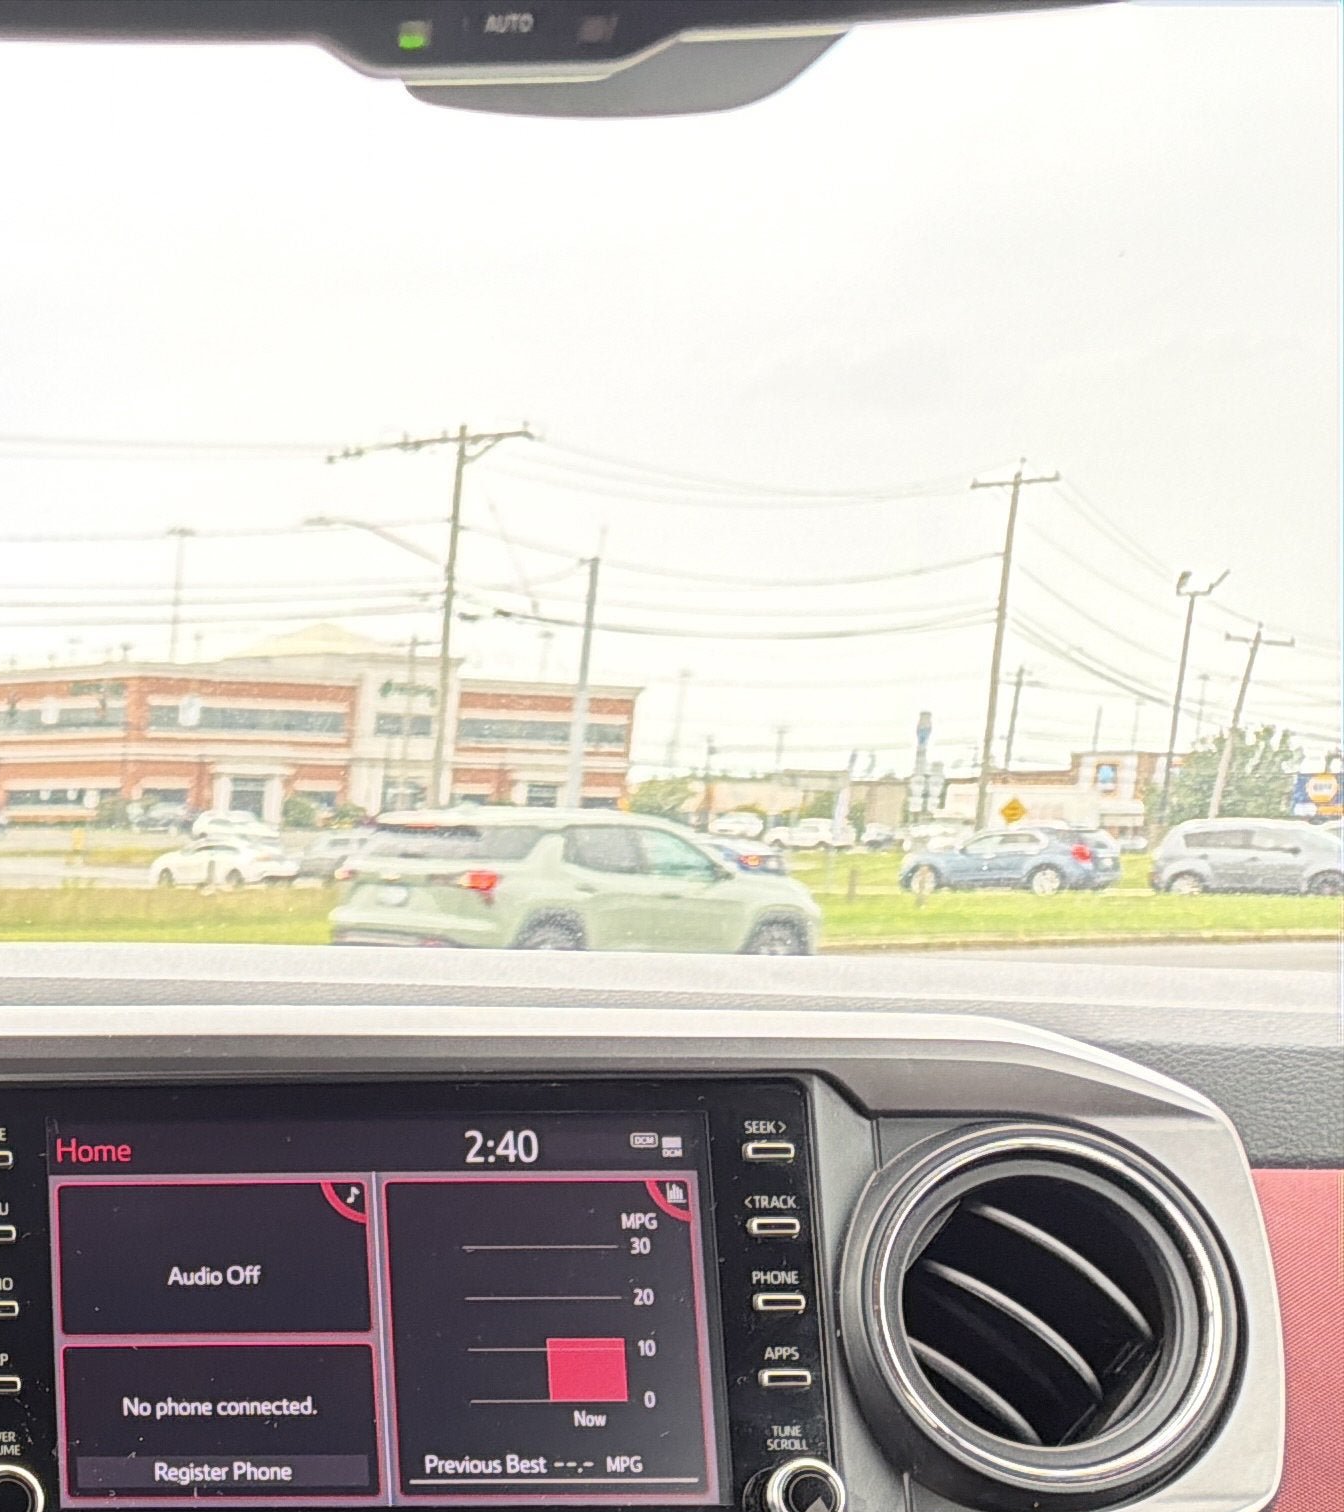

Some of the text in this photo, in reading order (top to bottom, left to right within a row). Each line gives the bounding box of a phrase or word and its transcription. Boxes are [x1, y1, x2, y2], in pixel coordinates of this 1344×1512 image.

[484, 13, 533, 32] AUTO
[56, 1138, 131, 1163] Home
[464, 1130, 539, 1163] 2:40
[621, 1213, 658, 1230] MPG
[630, 1237, 651, 1254] 30
[167, 1265, 262, 1286] Audio Off
[752, 1271, 799, 1284] PHONE
[633, 1288, 655, 1305] 20
[637, 1340, 656, 1356] 10
[764, 1347, 799, 1360] APPS
[122, 1396, 318, 1420] No phone connected.
[643, 1391, 656, 1408] 0
[573, 1411, 606, 1427] Now
[772, 1425, 801, 1437] TUNE
[767, 1438, 808, 1450] SCROLL
[424, 1455, 503, 1474] Previous
[506, 1454, 548, 1474] Best
[606, 1456, 643, 1473] MPG
[154, 1461, 292, 1485] Register Phone
